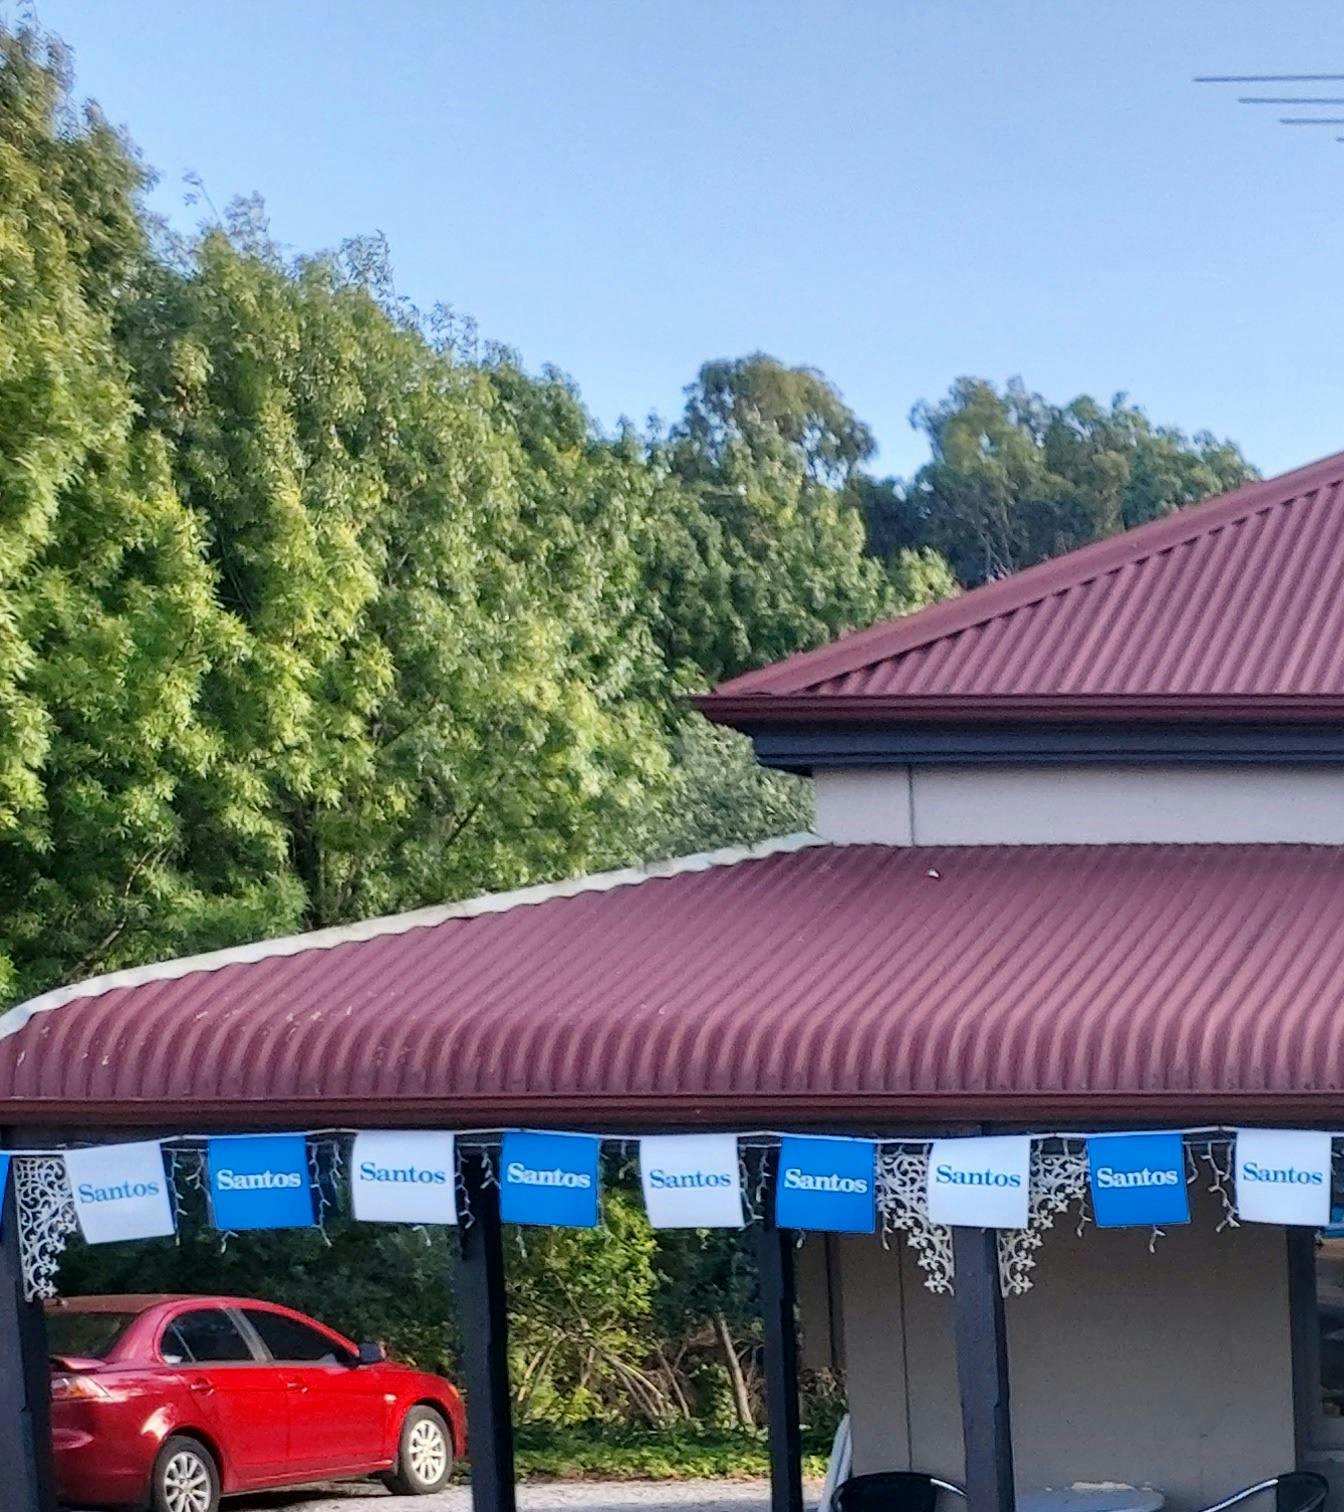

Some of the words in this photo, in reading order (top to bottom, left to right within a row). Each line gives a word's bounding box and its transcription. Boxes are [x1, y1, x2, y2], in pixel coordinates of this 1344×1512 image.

[216, 1168, 304, 1192] Santos
[359, 1162, 446, 1185] Santos
[507, 1162, 591, 1188] Santos
[649, 1169, 732, 1189] Santos
[785, 1167, 868, 1191] Santos
[935, 1165, 1021, 1188] Santos
[1096, 1168, 1178, 1189] Santos
[1242, 1162, 1323, 1185] Santos
[78, 1179, 160, 1204] Santos
